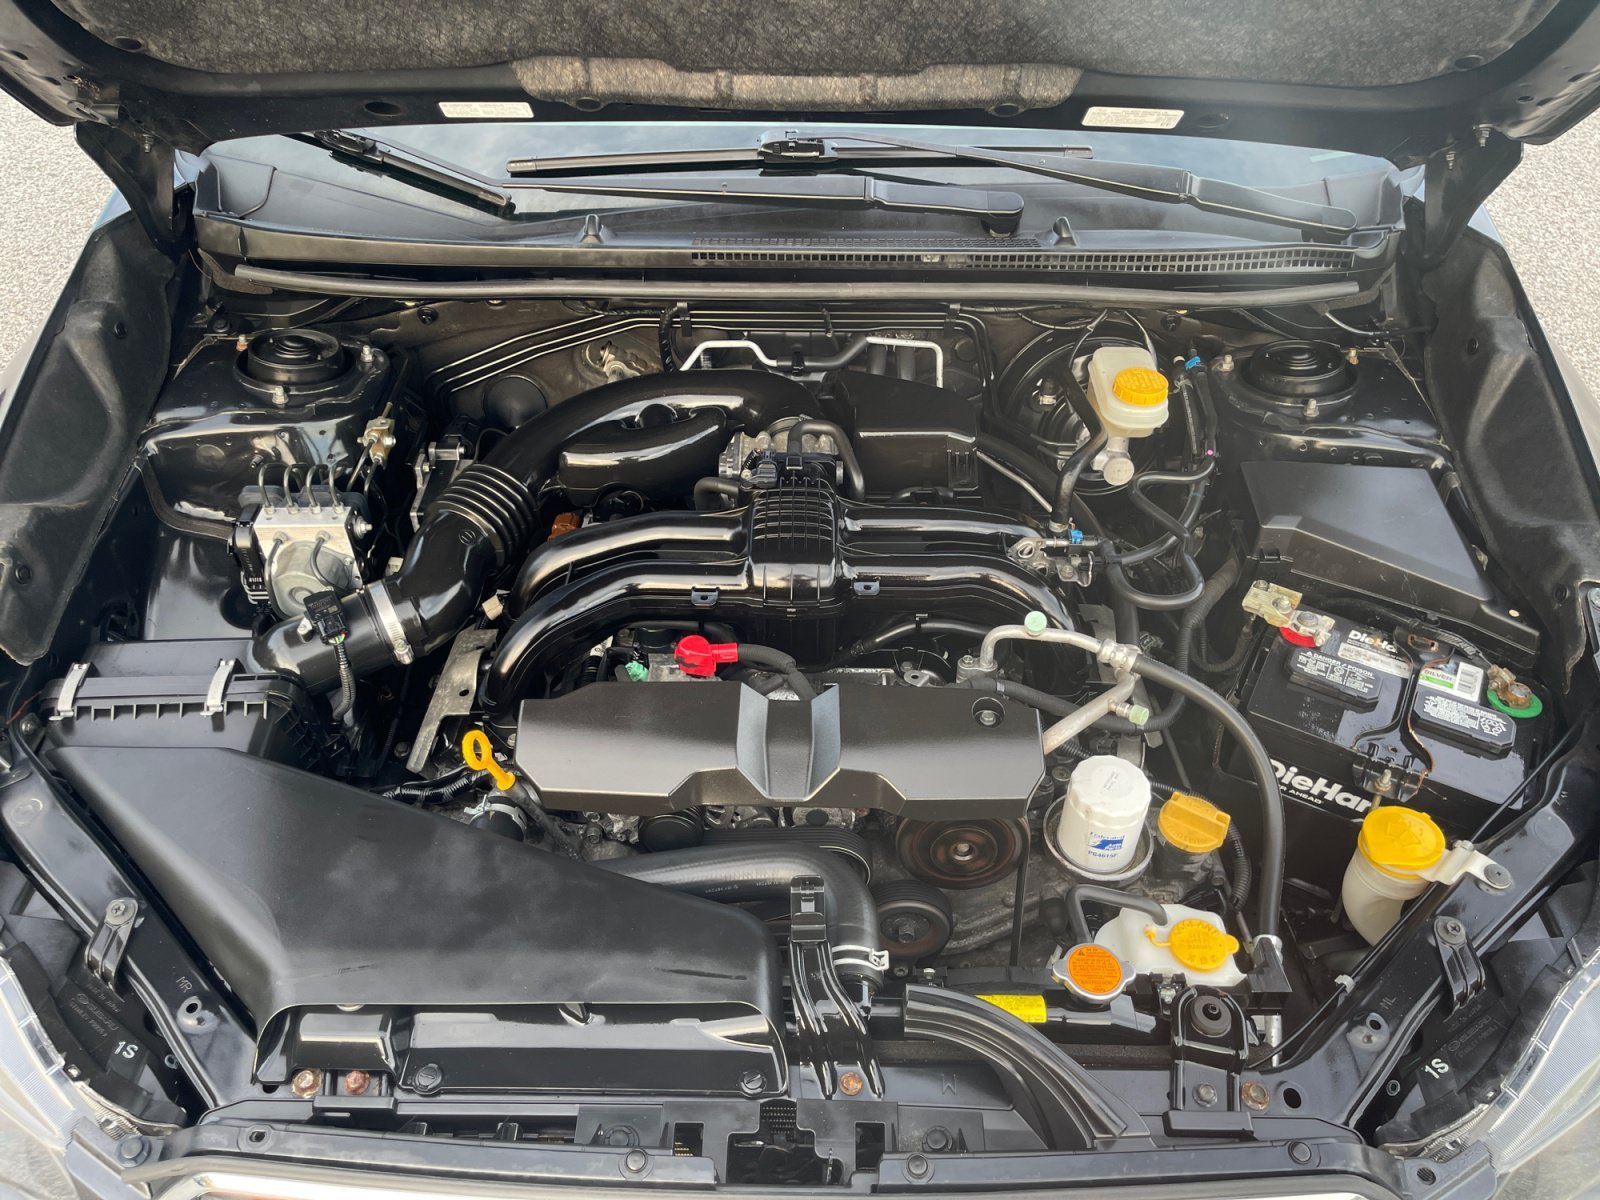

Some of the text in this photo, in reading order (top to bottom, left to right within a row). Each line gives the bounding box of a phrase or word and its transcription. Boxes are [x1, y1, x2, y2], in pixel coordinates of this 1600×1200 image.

[1313, 652, 1341, 668] DANGER
[1347, 664, 1374, 678] POISON
[1270, 758, 1372, 812] DieHar
[1288, 789, 1323, 804] AHEAD
[114, 1040, 139, 1059] 1S
[1424, 1058, 1449, 1079] 1S
